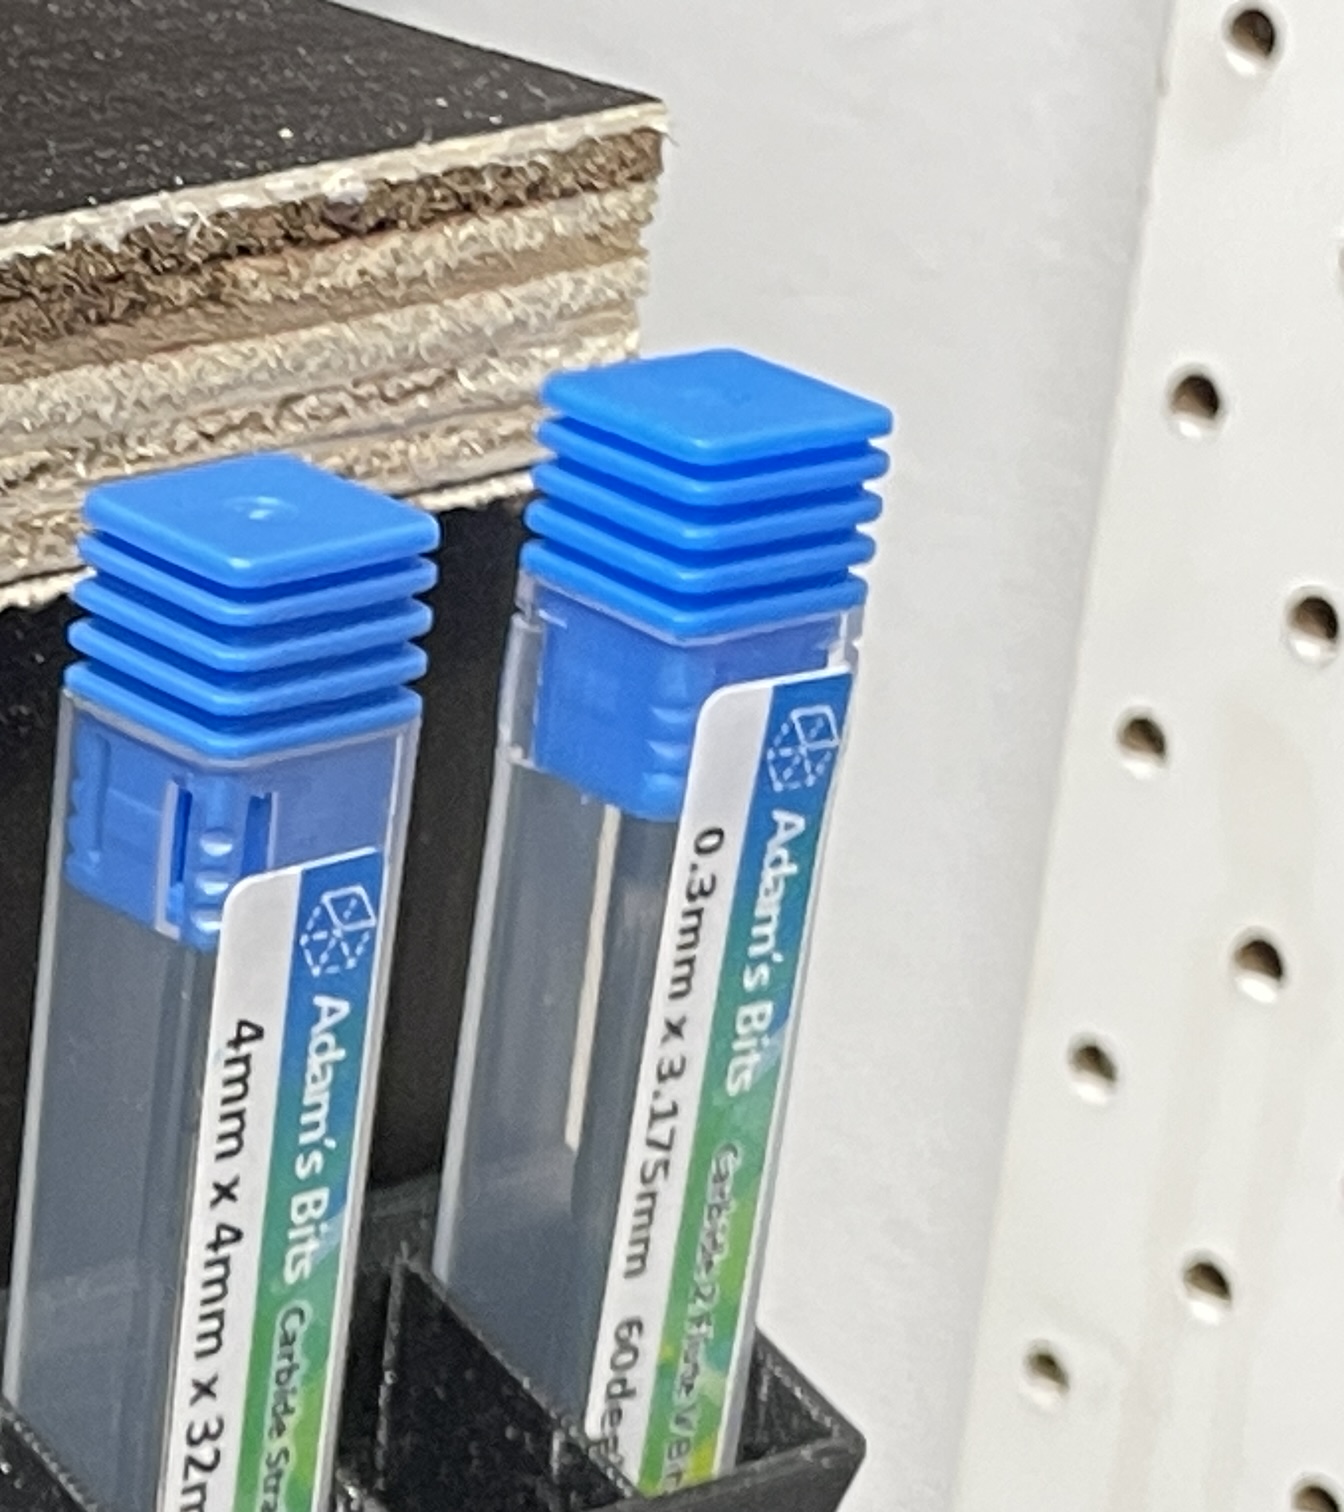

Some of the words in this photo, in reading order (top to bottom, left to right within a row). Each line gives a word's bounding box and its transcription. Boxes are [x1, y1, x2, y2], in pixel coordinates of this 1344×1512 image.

[667, 825, 726, 1000] 0.3mm
[743, 808, 808, 994] Adam's
[215, 1017, 265, 1161] 4mm
[293, 994, 352, 1182] Adam's
[659, 1013, 688, 1046] x
[724, 1001, 775, 1099] Bits
[210, 1175, 241, 1211] x
[622, 1054, 687, 1281] 3.175mm
[193, 1223, 245, 1361] 4mm
[282, 1186, 330, 1286] Bits
[188, 1374, 219, 1407] x
[267, 1305, 305, 1440] Carbide
